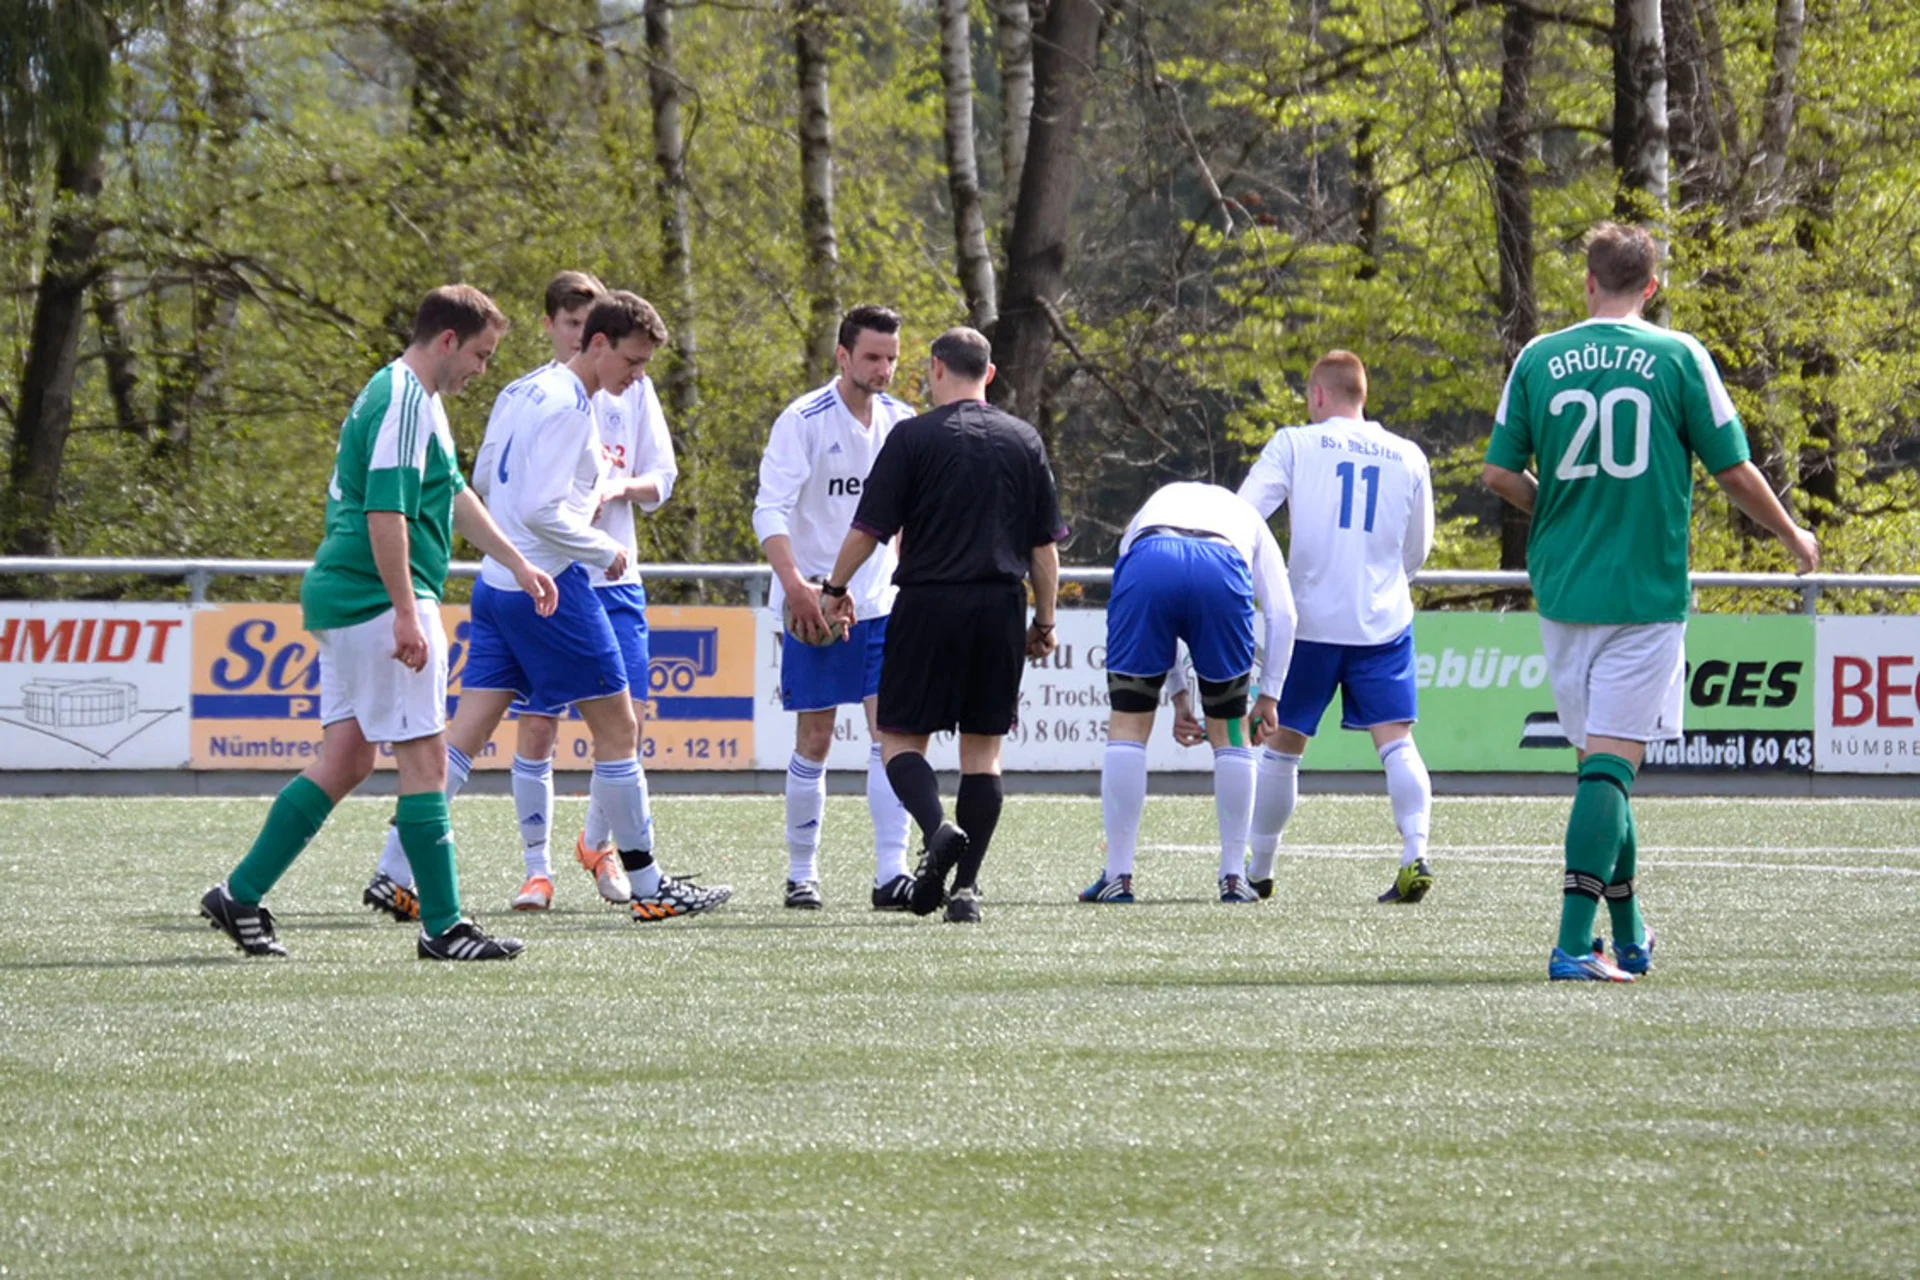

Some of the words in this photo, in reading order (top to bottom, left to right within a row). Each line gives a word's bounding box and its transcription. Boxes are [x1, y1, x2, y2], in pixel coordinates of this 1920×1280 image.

[1548, 342, 1657, 380] BRÖLTAL
[1549, 386, 1652, 481] 20
[828, 476, 866, 496] ne
[1336, 460, 1380, 533] 11
[1416, 647, 1549, 688] ebüro
[1686, 660, 1803, 708] GES
[1039, 683, 1111, 708] Trocke
[1832, 655, 1920, 728] BE
[209, 735, 323, 758] Nümbrec
[684, 738, 710, 758] 12
[717, 738, 738, 758] 11
[1035, 719, 1048, 742] 8
[1054, 719, 1080, 742] 06
[1645, 735, 1746, 765] Waldbröl
[1751, 737, 1779, 765] 60
[1783, 737, 1813, 767] 43
